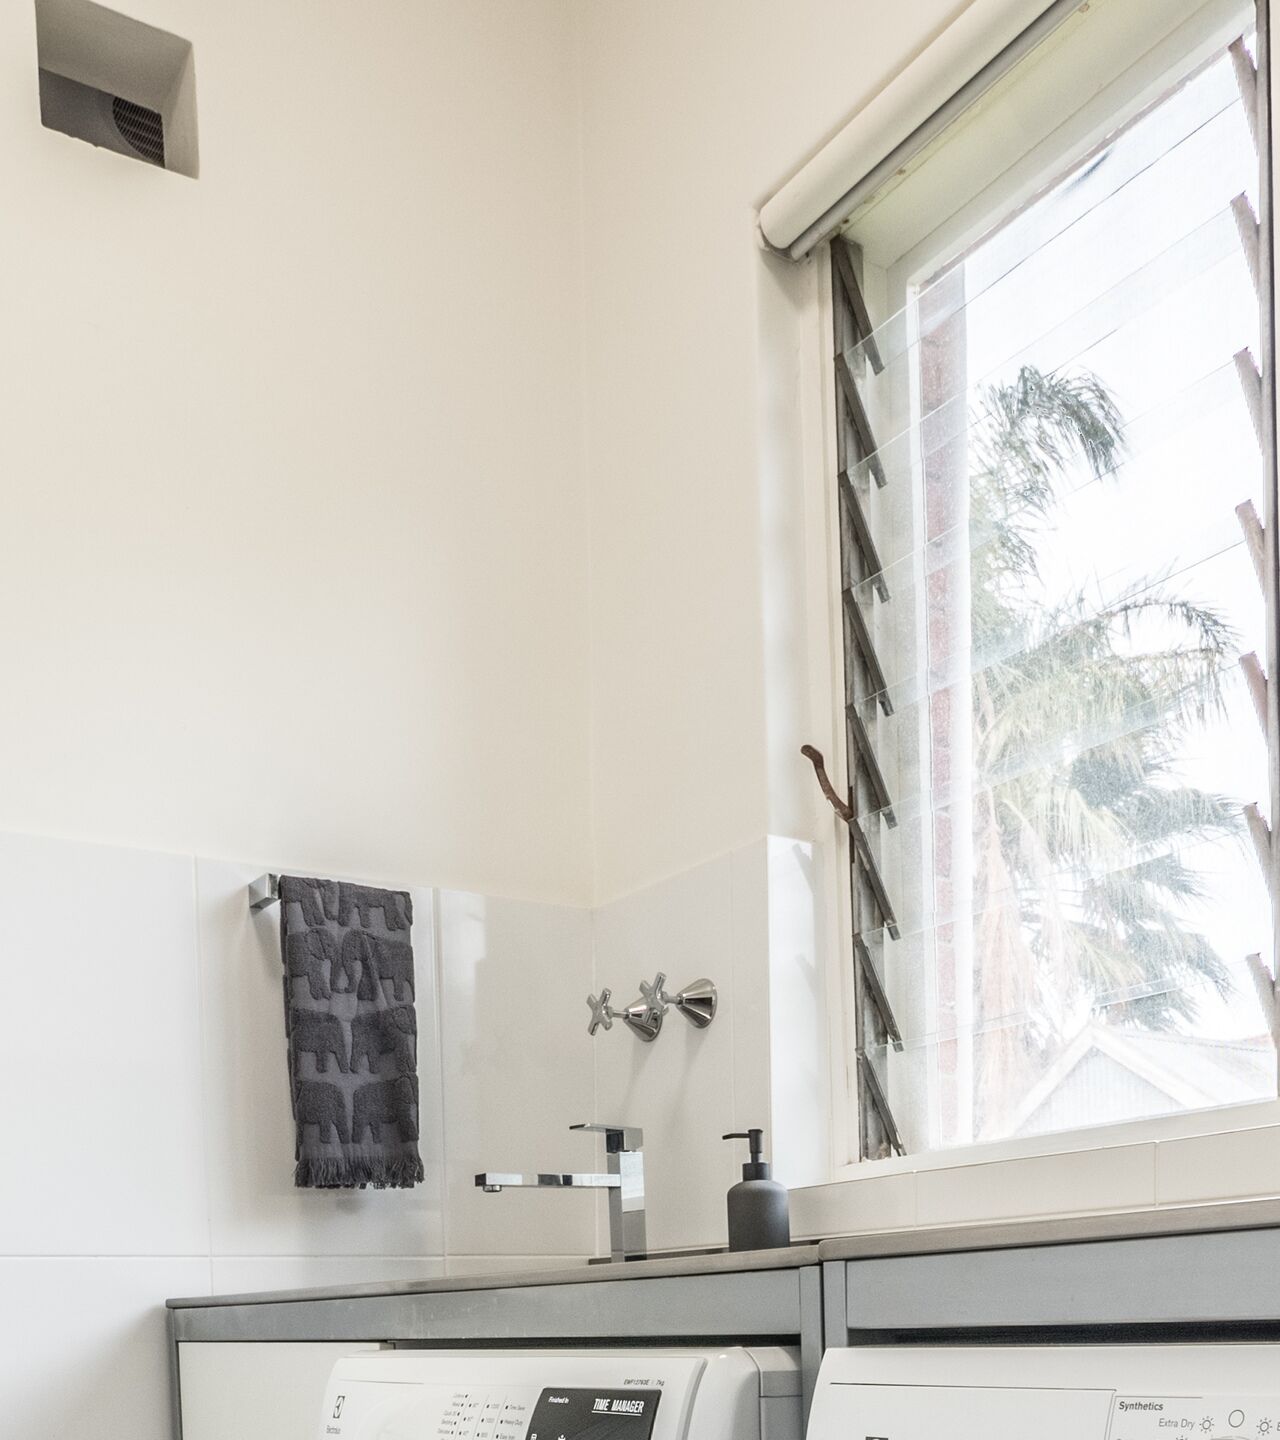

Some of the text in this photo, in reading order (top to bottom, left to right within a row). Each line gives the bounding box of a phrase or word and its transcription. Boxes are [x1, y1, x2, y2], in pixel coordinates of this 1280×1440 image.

[593, 1398, 645, 1413] TIME MANAGER
[1118, 1401, 1164, 1412] Synthetics
[1158, 1418, 1196, 1431] Extra Dry
